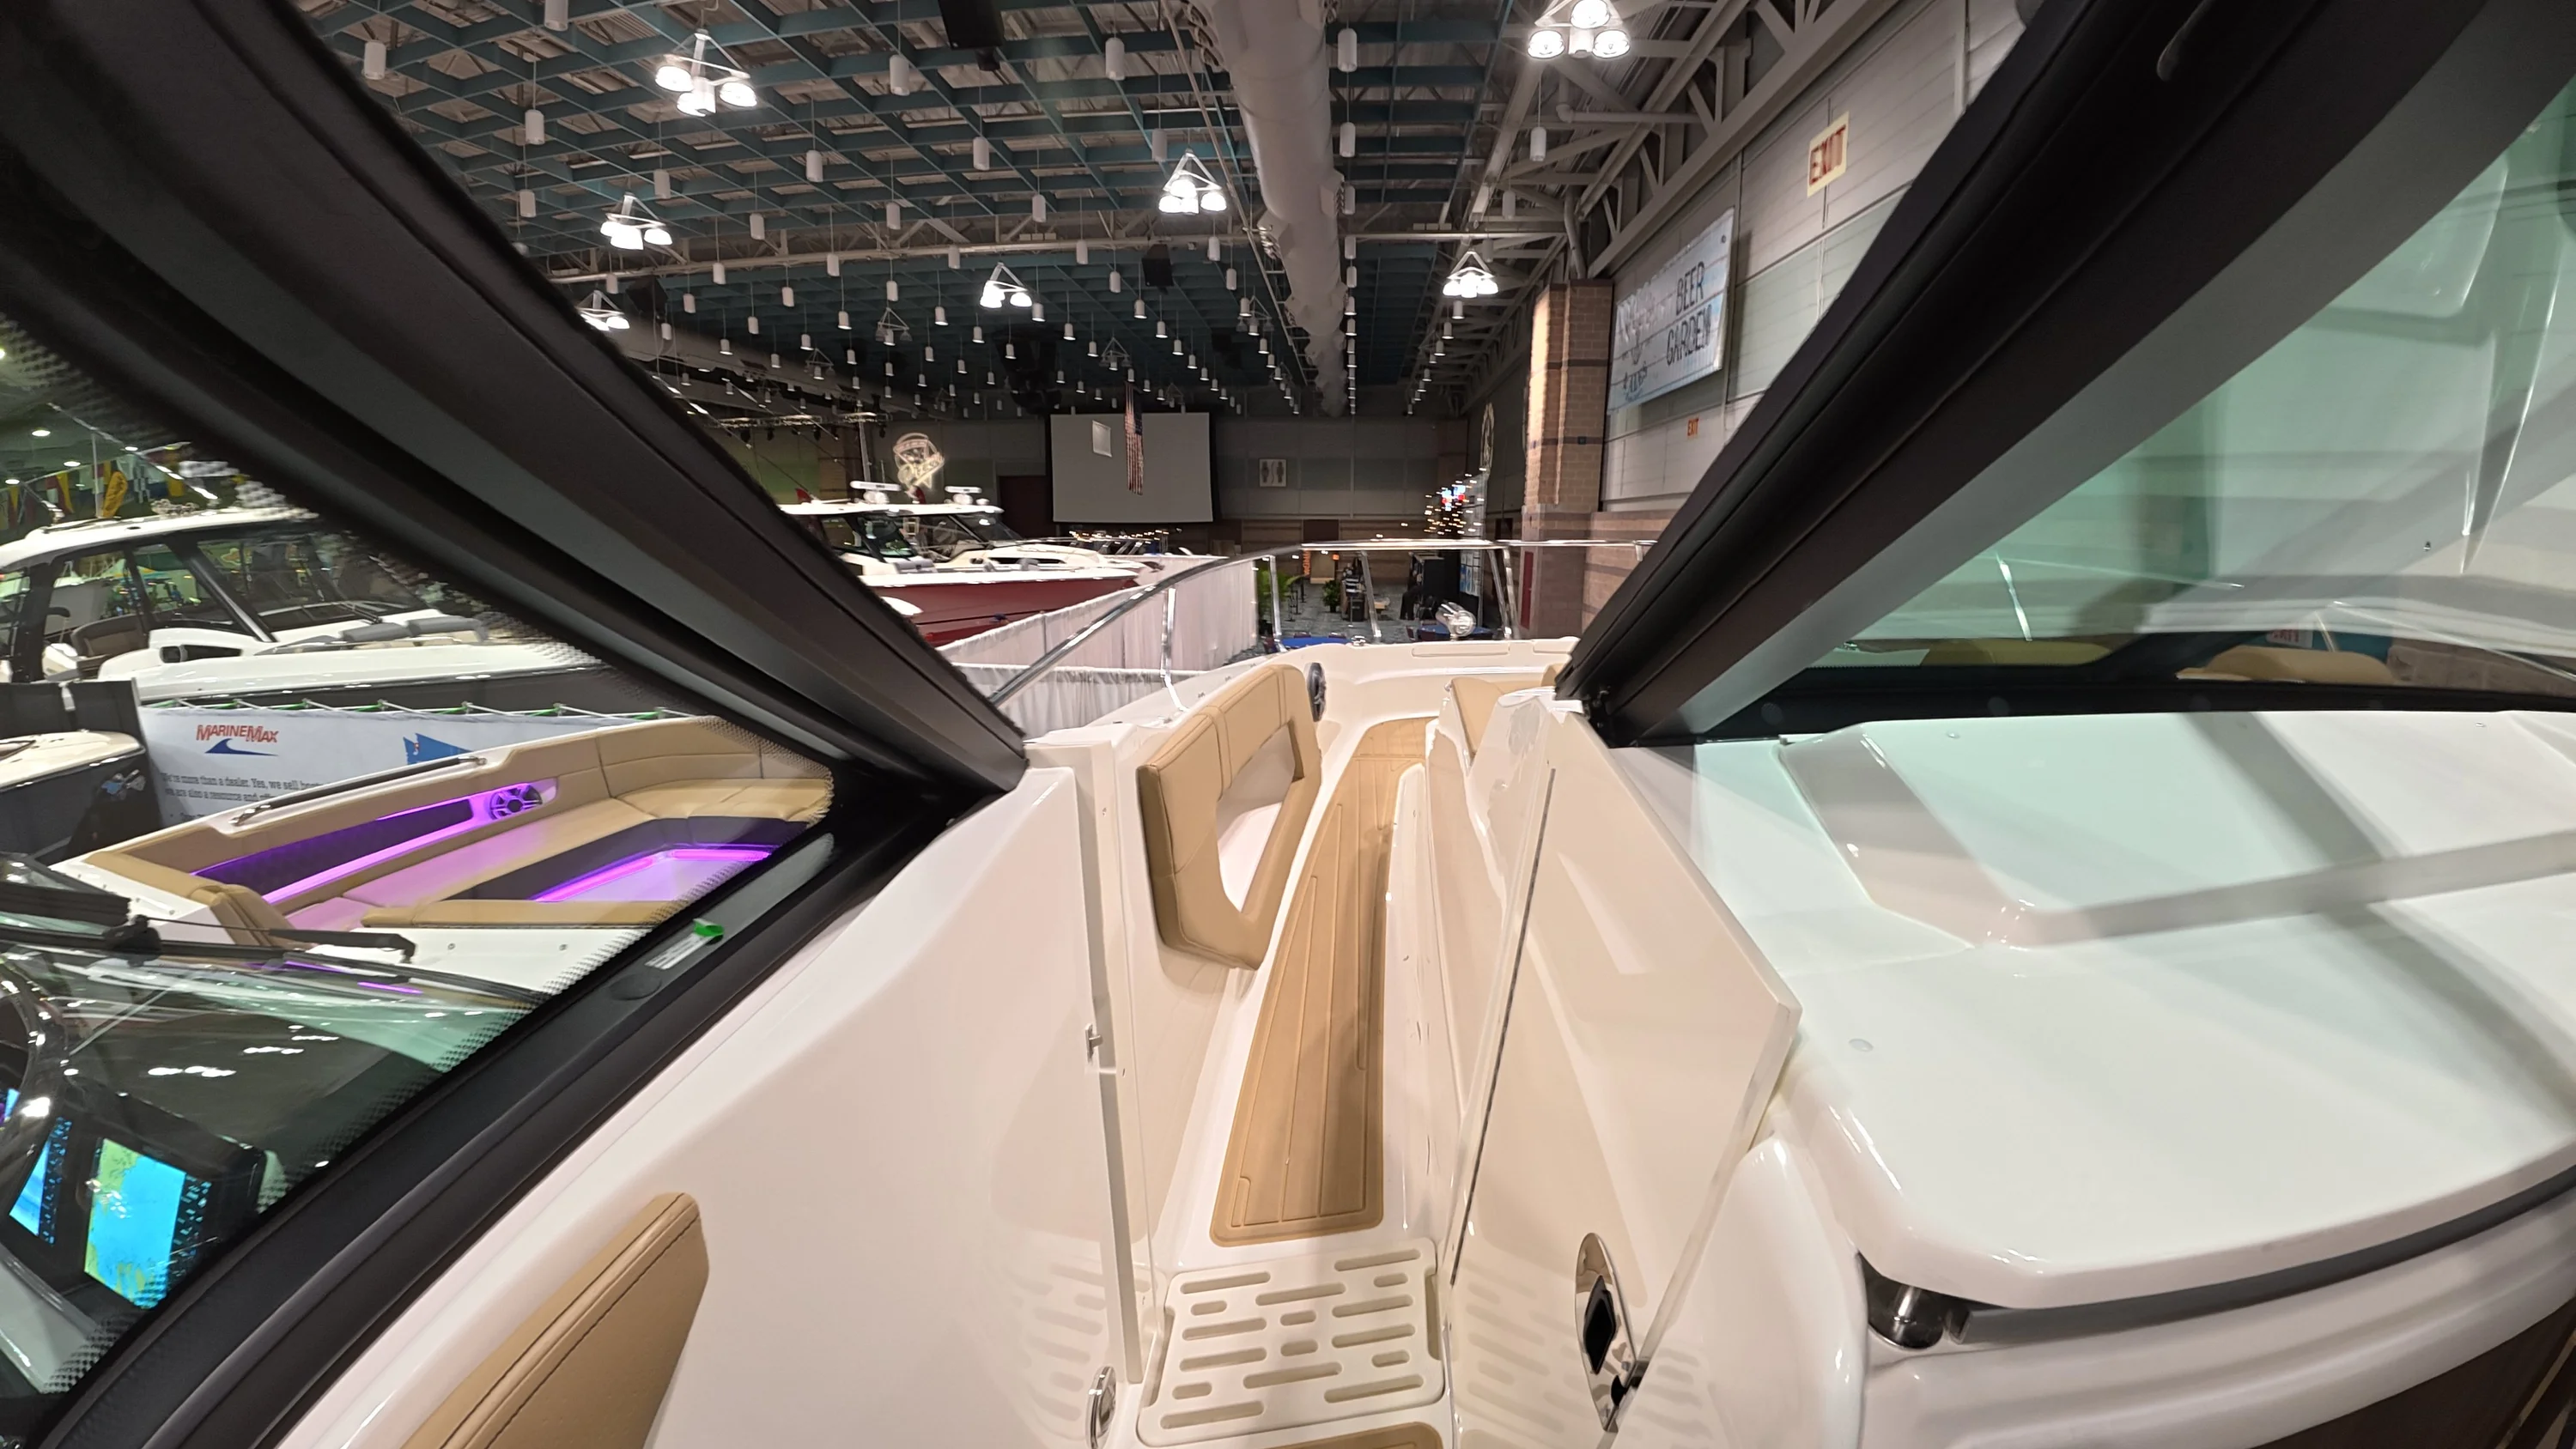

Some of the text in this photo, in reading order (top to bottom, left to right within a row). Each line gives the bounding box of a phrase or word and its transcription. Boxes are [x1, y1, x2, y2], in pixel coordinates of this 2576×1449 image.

[1808, 124, 1846, 186] EXIT
[1675, 260, 1705, 316] BEER
[1666, 303, 1712, 366] GARDEN
[1687, 418, 1699, 436] EXIT
[251, 778, 269, 790] Yes,
[269, 780, 282, 789] we
[283, 779, 299, 791] sell
